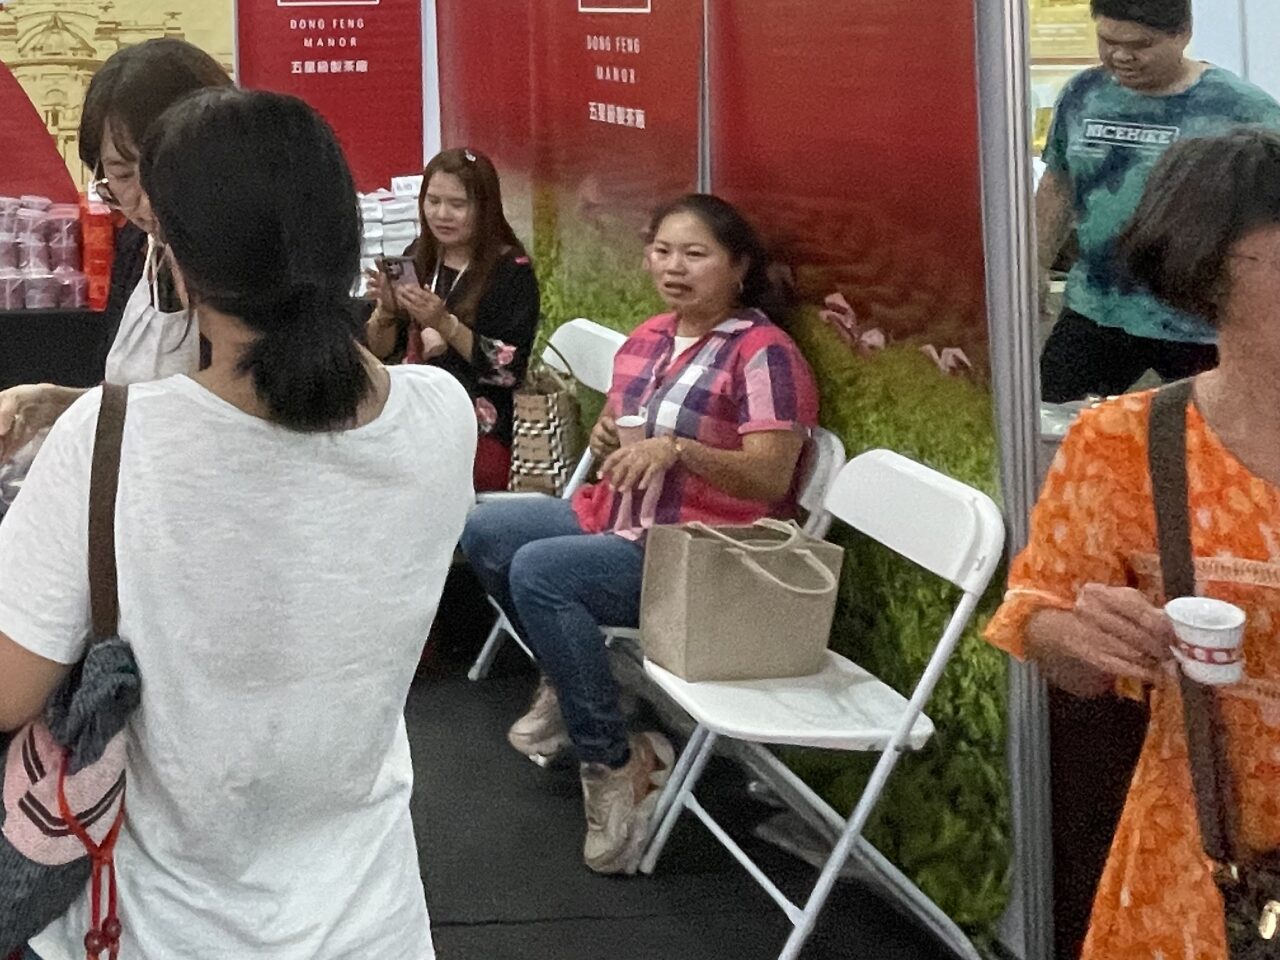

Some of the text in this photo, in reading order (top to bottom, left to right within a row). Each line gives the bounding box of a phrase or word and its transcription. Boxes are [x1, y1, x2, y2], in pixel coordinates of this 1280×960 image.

[290, 18, 365, 30] DONG FENG
[303, 37, 357, 48] MANOR
[586, 35, 640, 54] DONG FENG
[596, 65, 636, 84] MANOR
